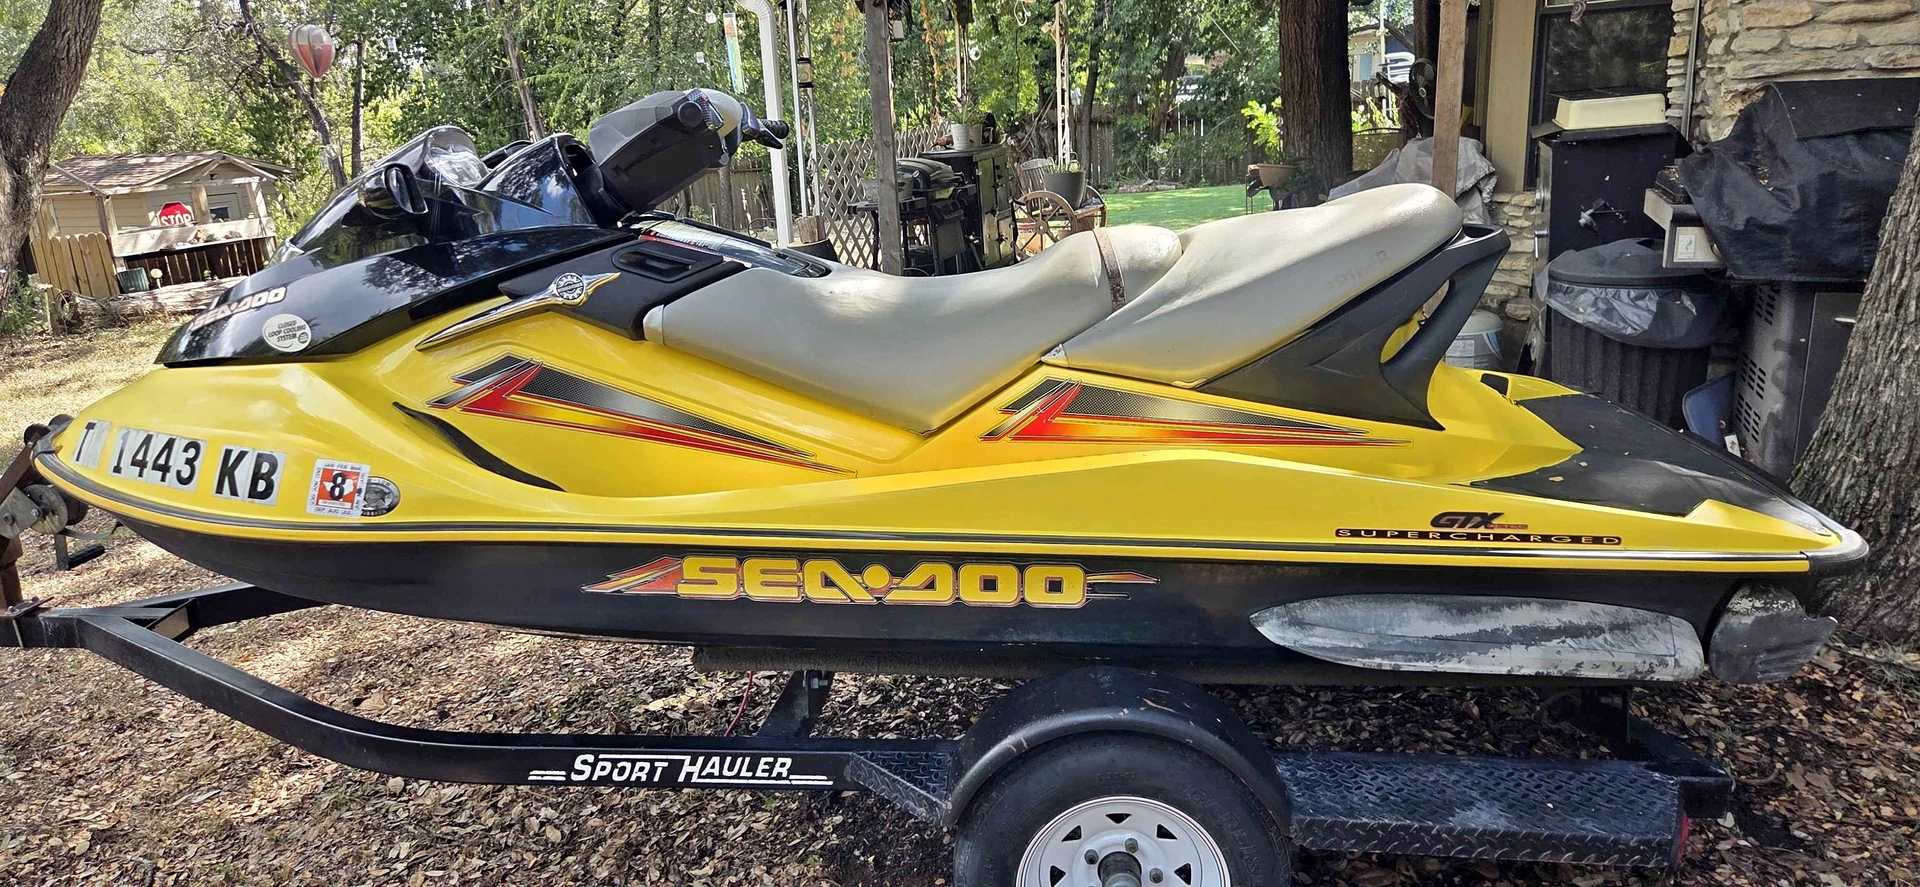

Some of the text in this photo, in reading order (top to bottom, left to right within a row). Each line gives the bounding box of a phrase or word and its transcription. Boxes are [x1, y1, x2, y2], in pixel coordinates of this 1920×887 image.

[160, 213, 192, 226] STOP
[268, 324, 307, 338] LOOP COOLING
[277, 320, 298, 329] CLOSED
[277, 333, 298, 342] SYSTEM
[112, 430, 201, 486] 1443
[214, 448, 279, 501] KB
[329, 472, 347, 501] 8
[1430, 511, 1505, 529] GTX
[1337, 528, 1620, 545] SUPERCHARGED
[570, 754, 792, 783] SPORT HAULER
